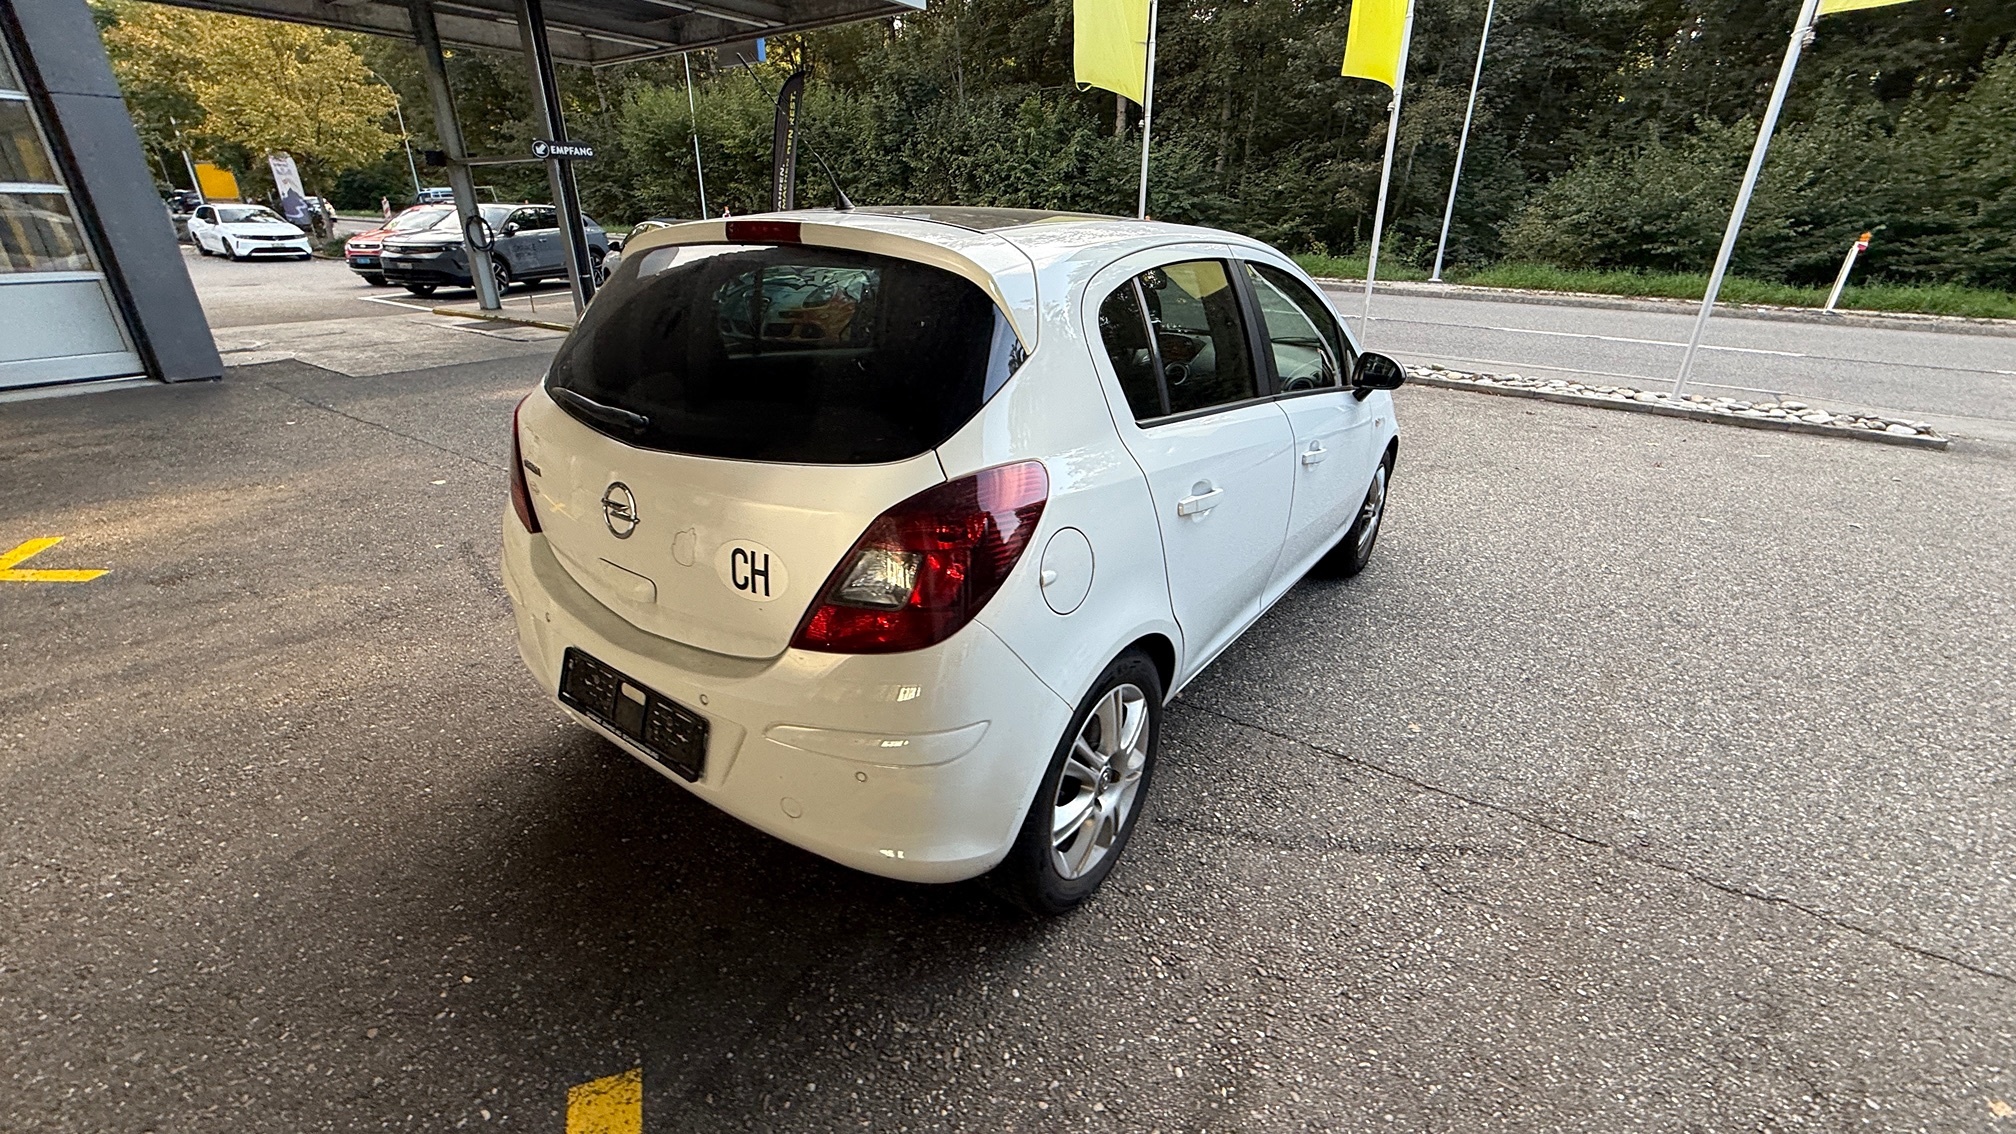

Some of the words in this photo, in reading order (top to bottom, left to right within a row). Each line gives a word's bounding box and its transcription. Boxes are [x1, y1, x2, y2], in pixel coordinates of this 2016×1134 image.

[789, 90, 797, 126] REST.
[550, 145, 593, 156] EMPFANG
[786, 129, 794, 155] DEN
[731, 547, 770, 597] CH
